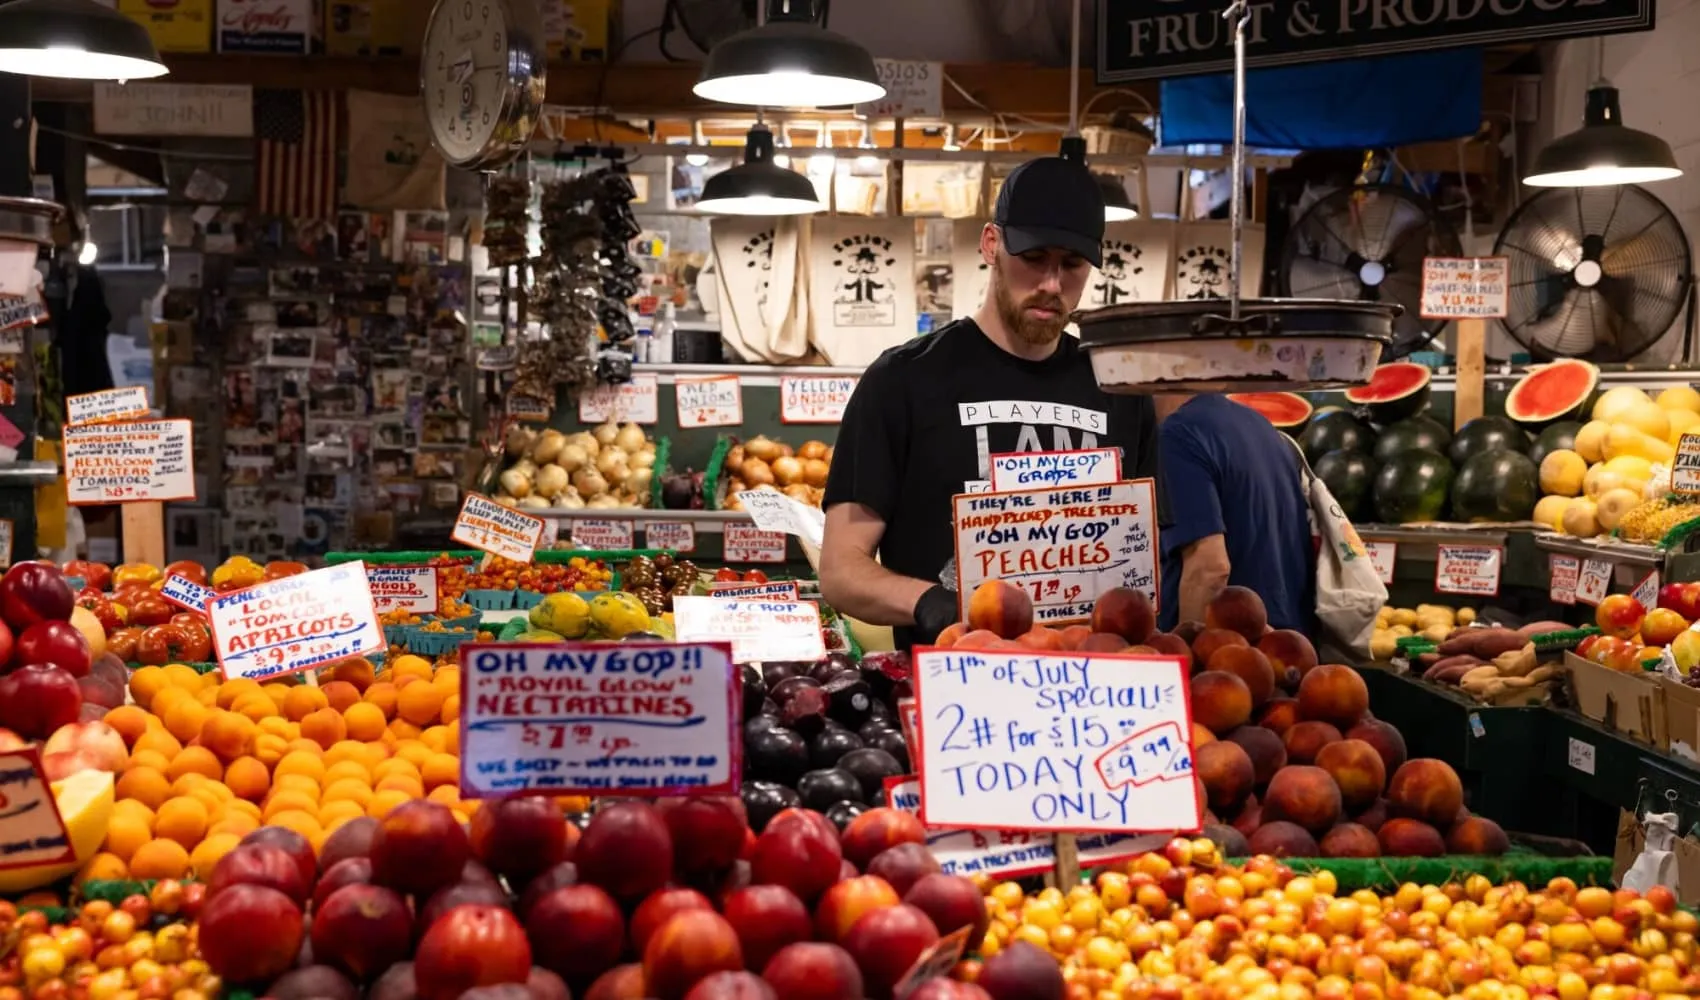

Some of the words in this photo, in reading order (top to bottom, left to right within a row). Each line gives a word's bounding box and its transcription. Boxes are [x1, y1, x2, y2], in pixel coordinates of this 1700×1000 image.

[1128, 2, 1274, 57] FRUIT
[1287, 0, 1324, 37] &
[1336, 0, 1606, 33] PROD
[789, 380, 850, 393] YELLOW
[789, 392, 847, 406] ONIONS
[966, 403, 1101, 430] PLAYERS
[71, 467, 150, 477] BEEFSTEAK
[75, 457, 153, 468] HEIRLOOM
[78, 476, 150, 486] TOMATOES
[1018, 468, 1078, 486] GRAPE
[969, 494, 1035, 512] THEY'RE
[1050, 489, 1094, 506] HERE
[1100, 503, 1139, 515] RIPE
[576, 534, 630, 545] POTATOES
[976, 526, 1019, 546] "OH
[1028, 524, 1060, 544] MY
[1065, 517, 1120, 542] GOD"
[974, 541, 1111, 577] PEACHES
[1123, 569, 1139, 580] WE
[370, 582, 416, 590] NGOLD
[713, 585, 763, 598] ORGANIC
[765, 584, 794, 594] MIXED
[1064, 585, 1082, 603] LB
[242, 592, 317, 614] LOCAL
[1037, 606, 1076, 619] TAKE
[228, 612, 354, 653] APRICOTS
[475, 652, 528, 673] OH
[543, 652, 599, 674] MY
[946, 656, 986, 684] 4th
[993, 660, 1018, 681] of
[477, 676, 592, 694] "ROYAL
[599, 675, 694, 694] GLOW"
[476, 694, 695, 717] NECTARINES
[936, 703, 997, 752] 2#
[1008, 721, 1041, 752] for
[941, 755, 1084, 796] TODAY
[1032, 783, 1130, 824] ONLY
